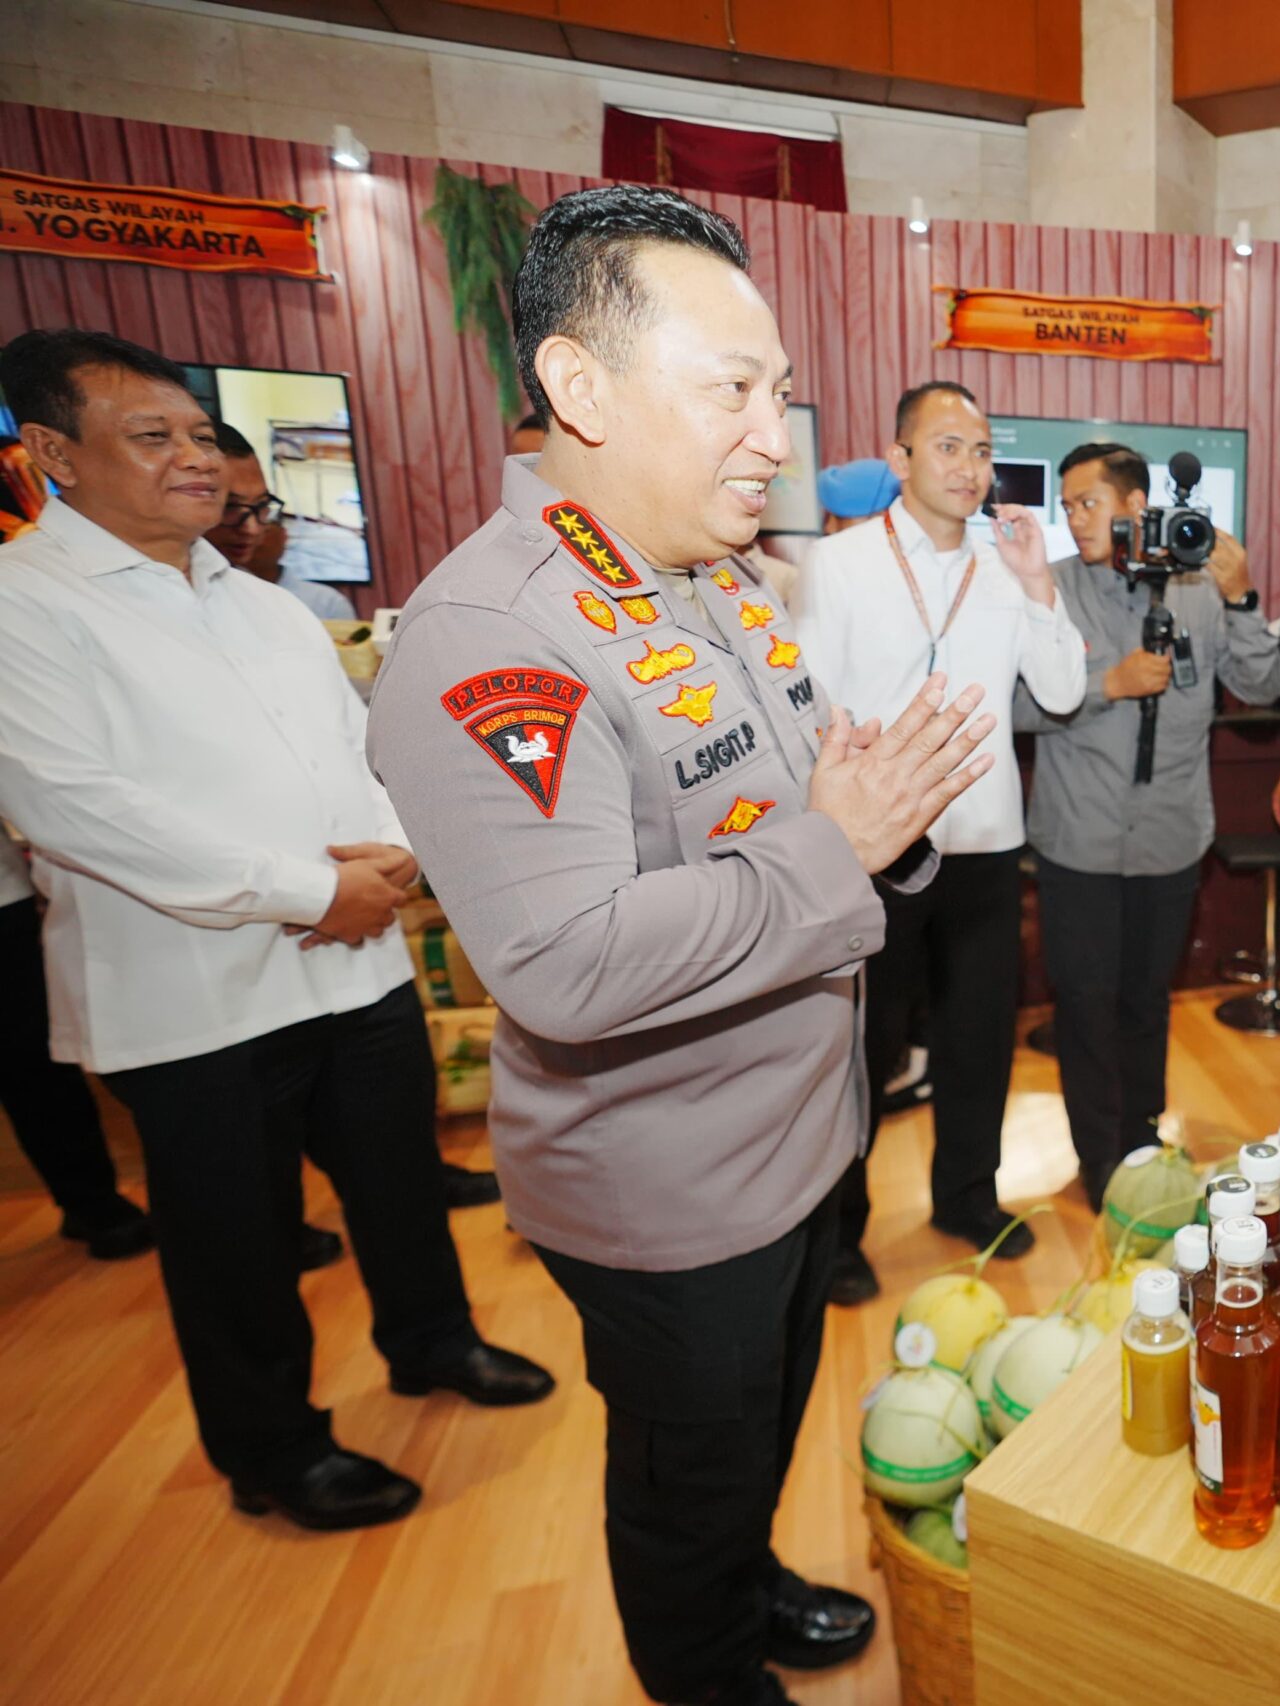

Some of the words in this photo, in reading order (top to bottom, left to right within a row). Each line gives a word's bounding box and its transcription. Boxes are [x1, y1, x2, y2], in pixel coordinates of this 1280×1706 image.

[12, 189, 101, 214] SATGAS
[106, 199, 205, 224] WILAYAH
[24, 209, 267, 259] YOGYAKARTA
[1022, 306, 1074, 320] SATGAS
[1079, 309, 1140, 324] WILAYAH
[1035, 322, 1126, 345] BANTEN
[455, 673, 574, 710] PELOPOR
[477, 711, 518, 738] KORPS
[523, 709, 567, 726] BRIMOB
